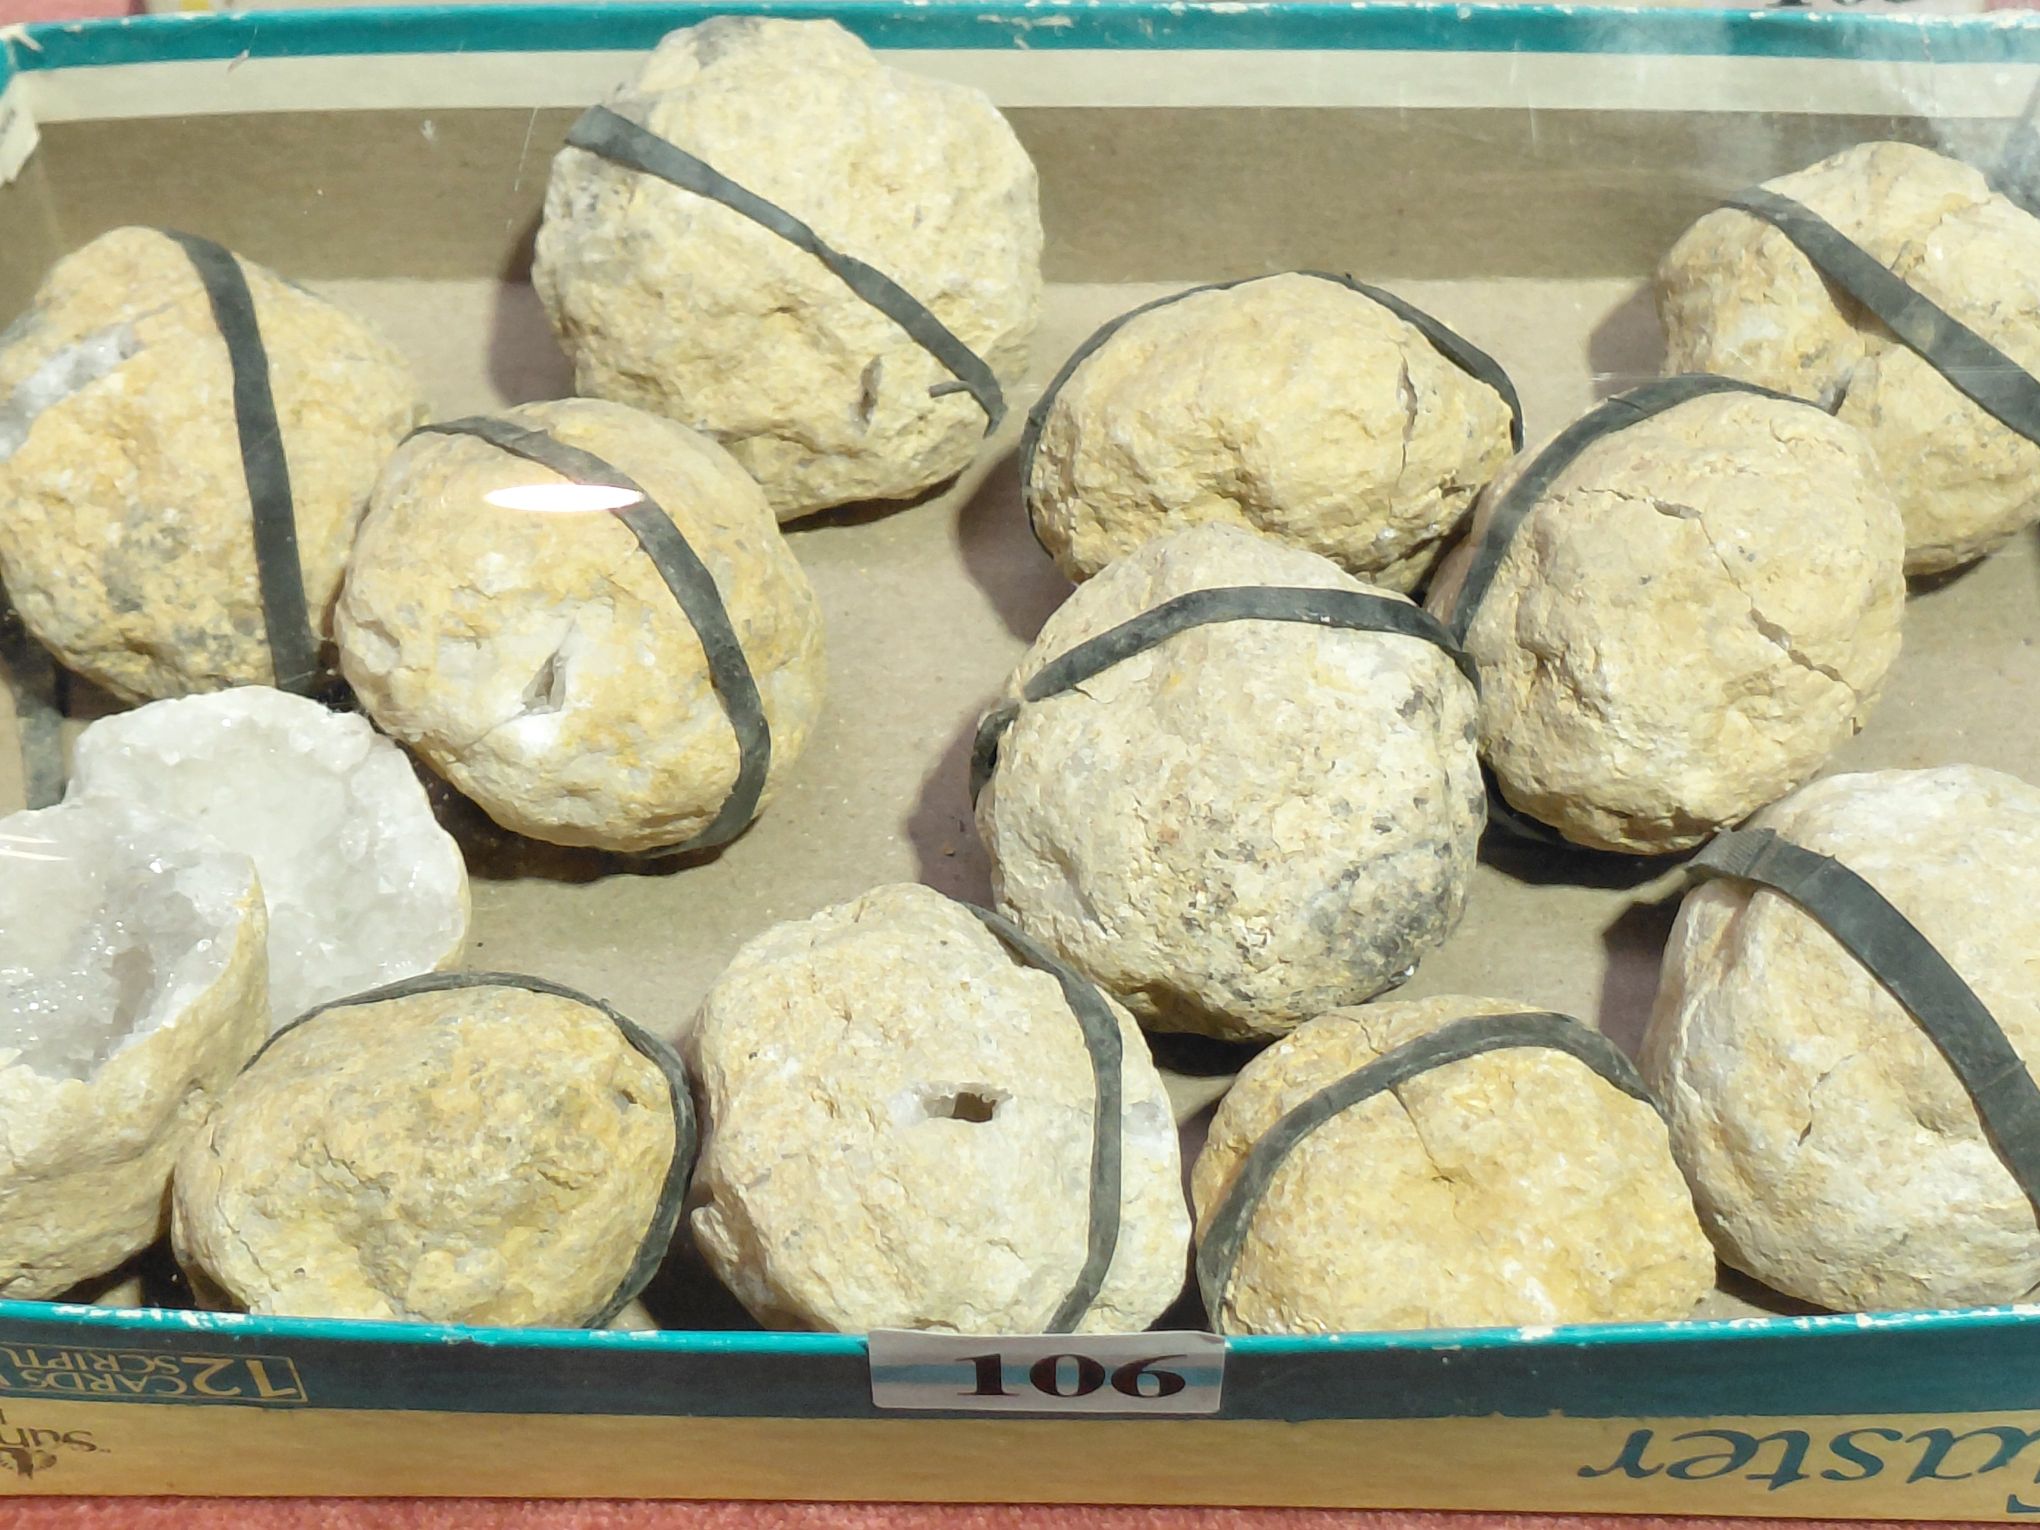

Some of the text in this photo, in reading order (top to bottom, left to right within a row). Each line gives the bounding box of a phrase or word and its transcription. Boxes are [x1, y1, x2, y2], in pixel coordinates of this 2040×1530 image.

[22, 1369, 188, 1394] CARDS
[181, 1357, 298, 1397] 12
[955, 1353, 1188, 1397] 106
